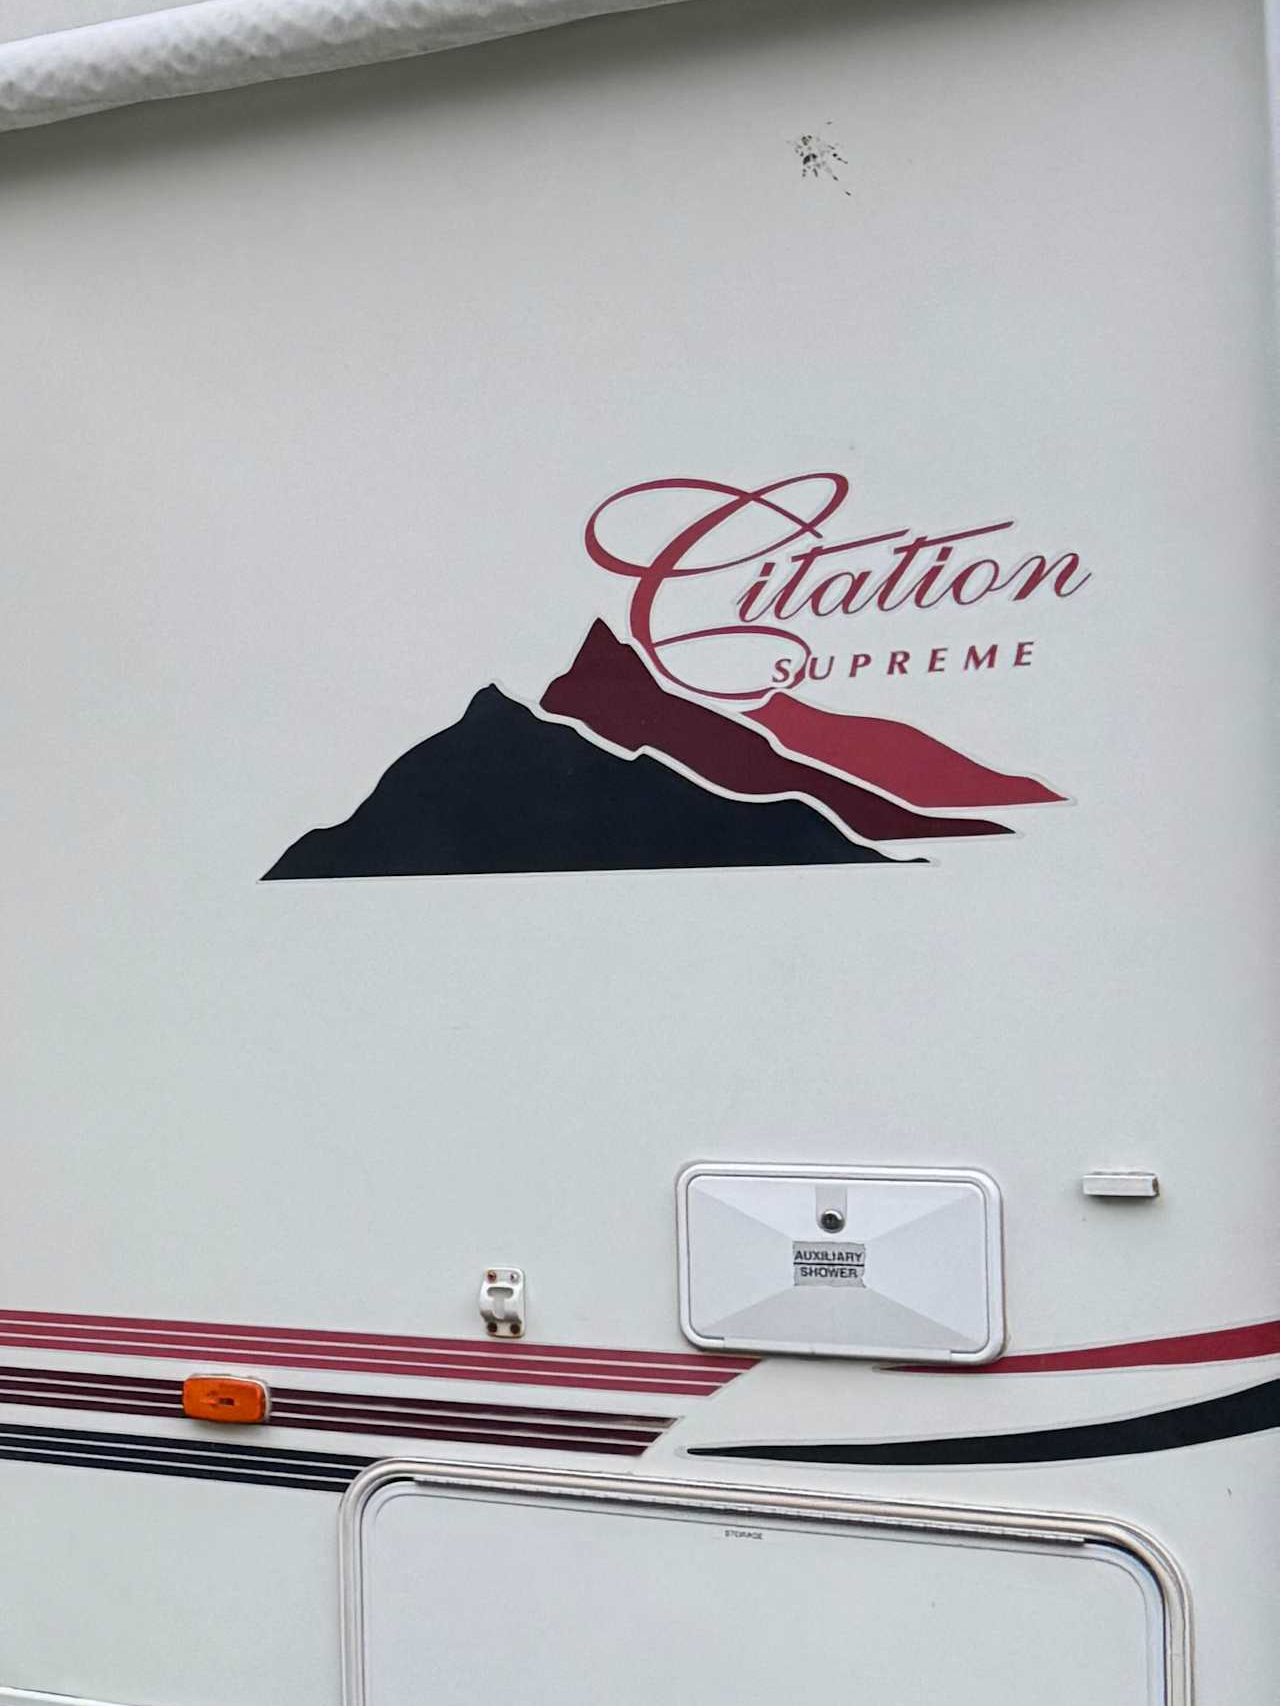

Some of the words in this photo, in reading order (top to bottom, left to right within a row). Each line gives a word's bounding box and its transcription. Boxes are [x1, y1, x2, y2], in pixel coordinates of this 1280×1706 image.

[584, 471, 1092, 701] Citation
[771, 640, 1037, 684] SUPREME
[793, 1250, 863, 1262] AUXILIARY
[800, 1266, 859, 1278] SHOWER
